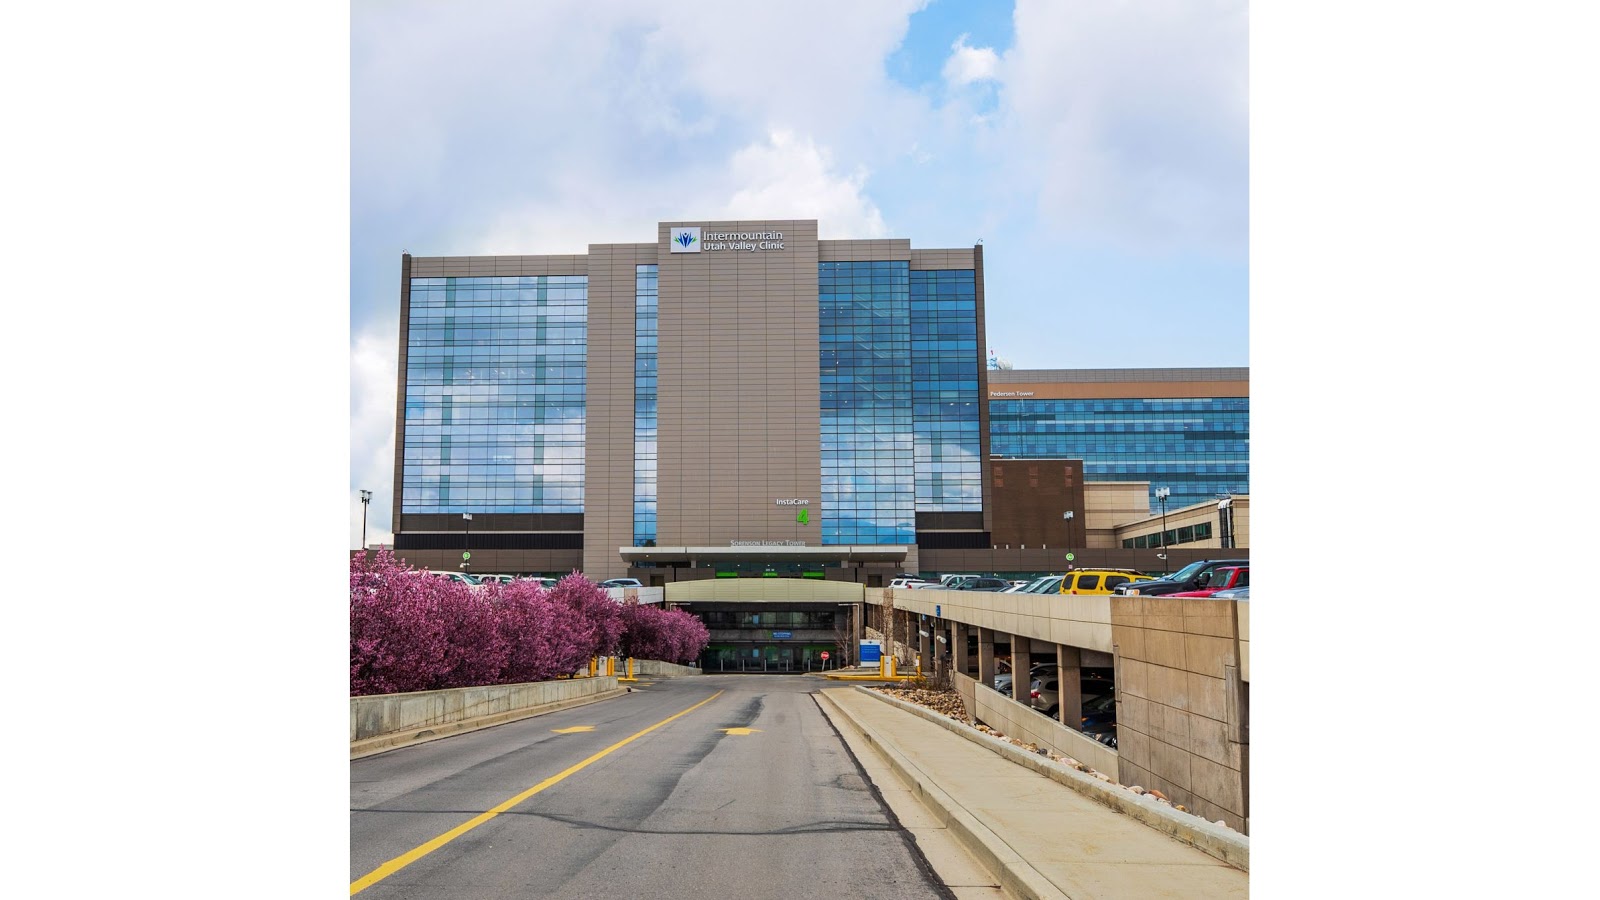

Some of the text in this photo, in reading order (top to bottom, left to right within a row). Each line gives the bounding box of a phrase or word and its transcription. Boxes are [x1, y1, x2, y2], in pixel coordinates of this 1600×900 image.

[703, 231, 783, 241] Intermountain
[703, 241, 785, 252] Utah Valley Clinic
[796, 508, 809, 525] 4
